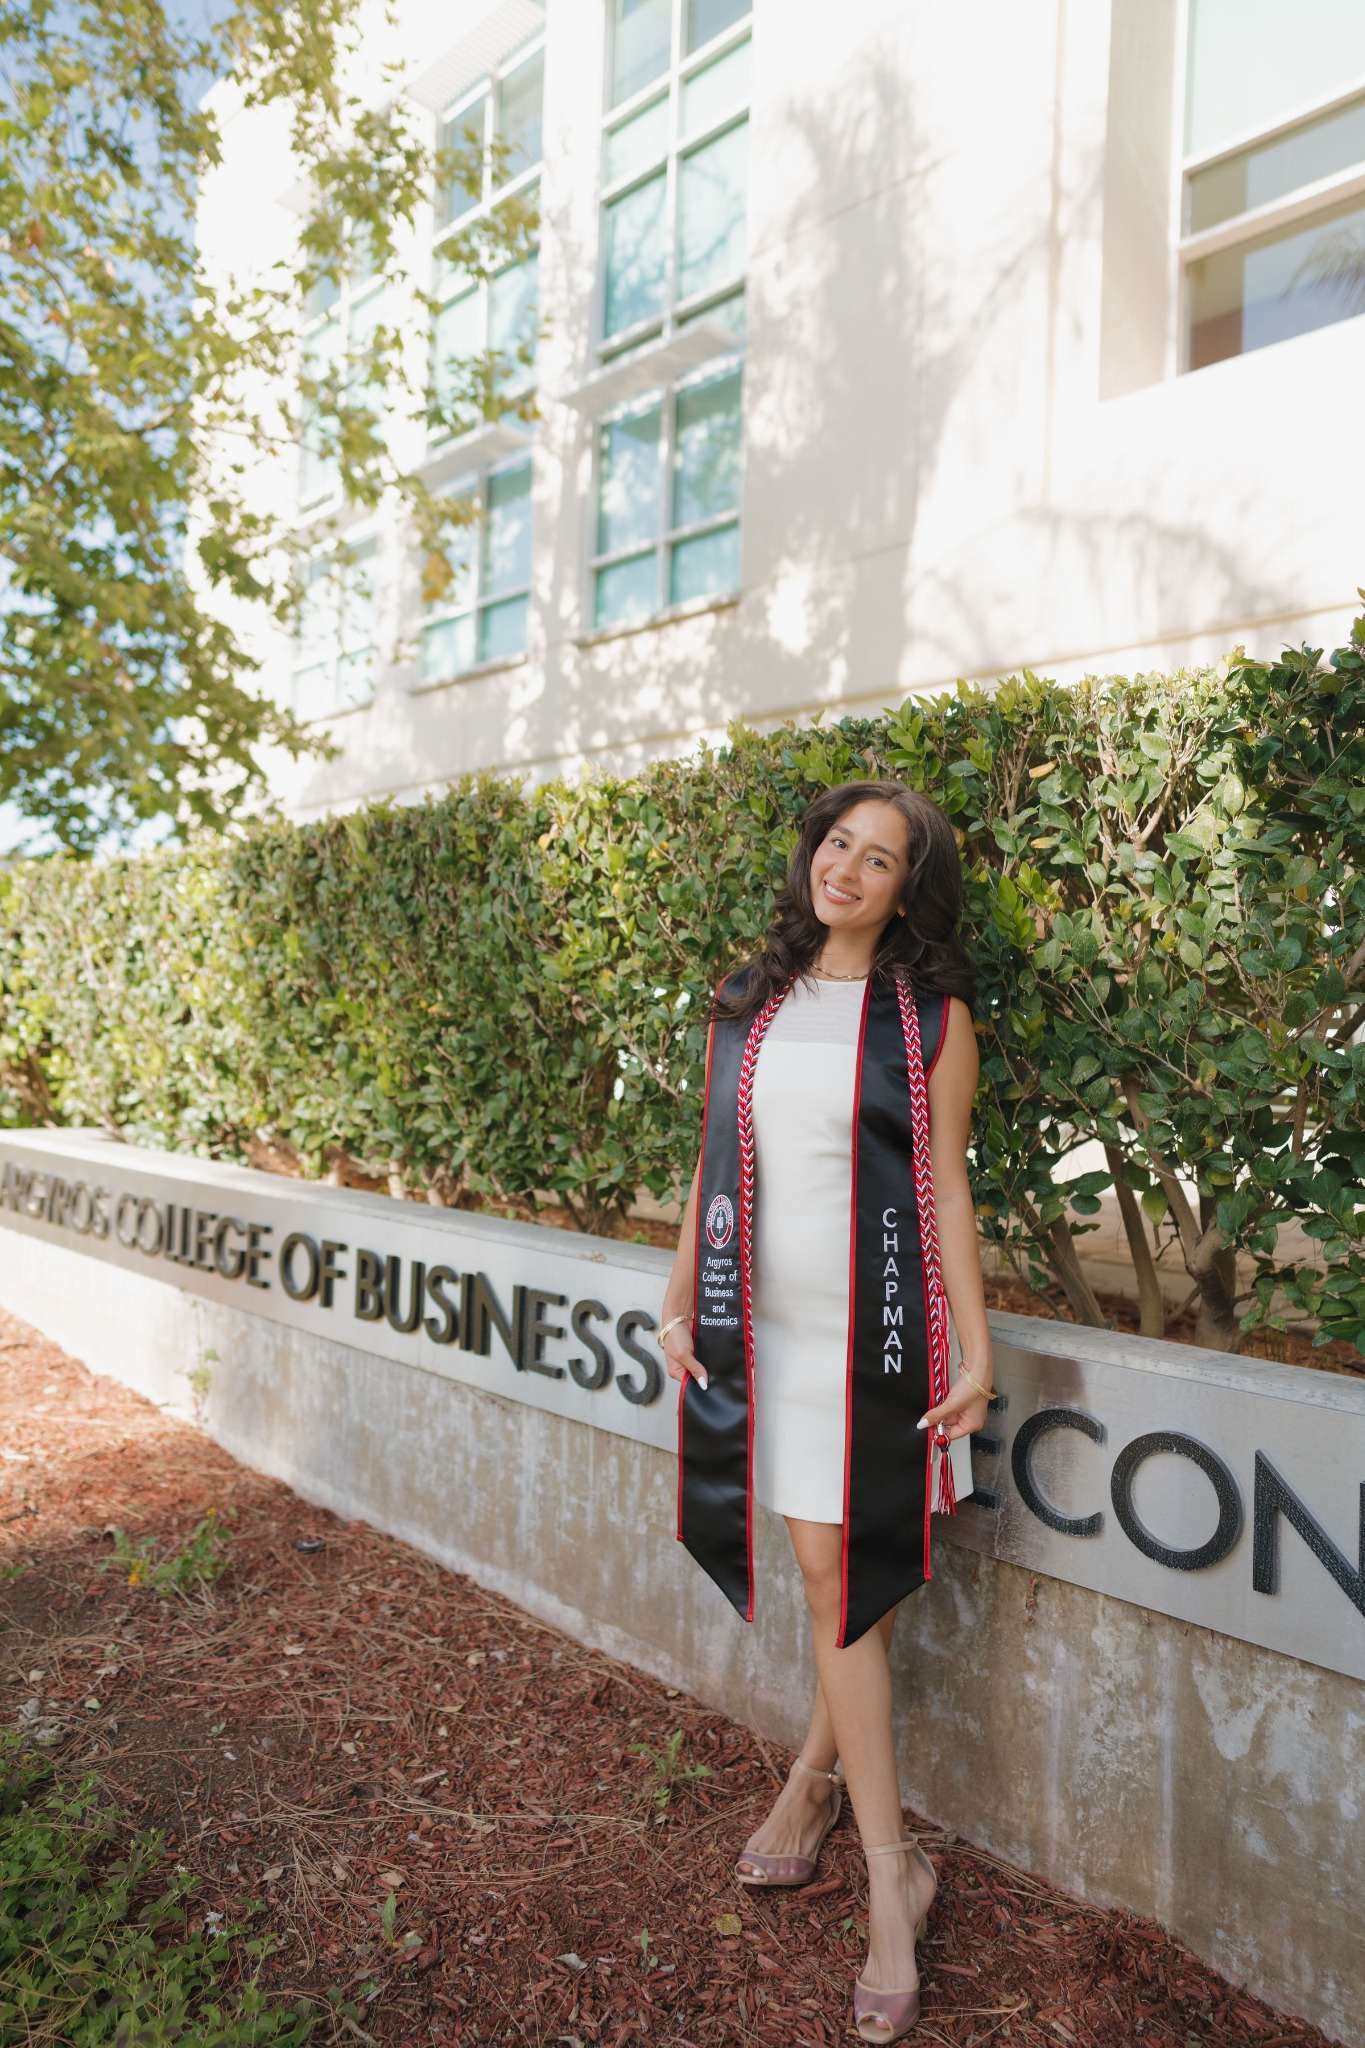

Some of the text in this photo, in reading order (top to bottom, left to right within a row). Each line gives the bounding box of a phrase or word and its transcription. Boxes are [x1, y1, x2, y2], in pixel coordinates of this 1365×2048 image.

[706, 1256, 733, 1269] Argyros
[702, 1270, 738, 1284] College of
[705, 1287, 734, 1298] Business
[882, 1207, 904, 1374] CHAPMAN
[116, 1192, 273, 1289] COLLEGE
[279, 1232, 348, 1308] OF
[354, 1248, 665, 1406] BUSINESS
[712, 1302, 726, 1313] and
[700, 1315, 738, 1326] Economics
